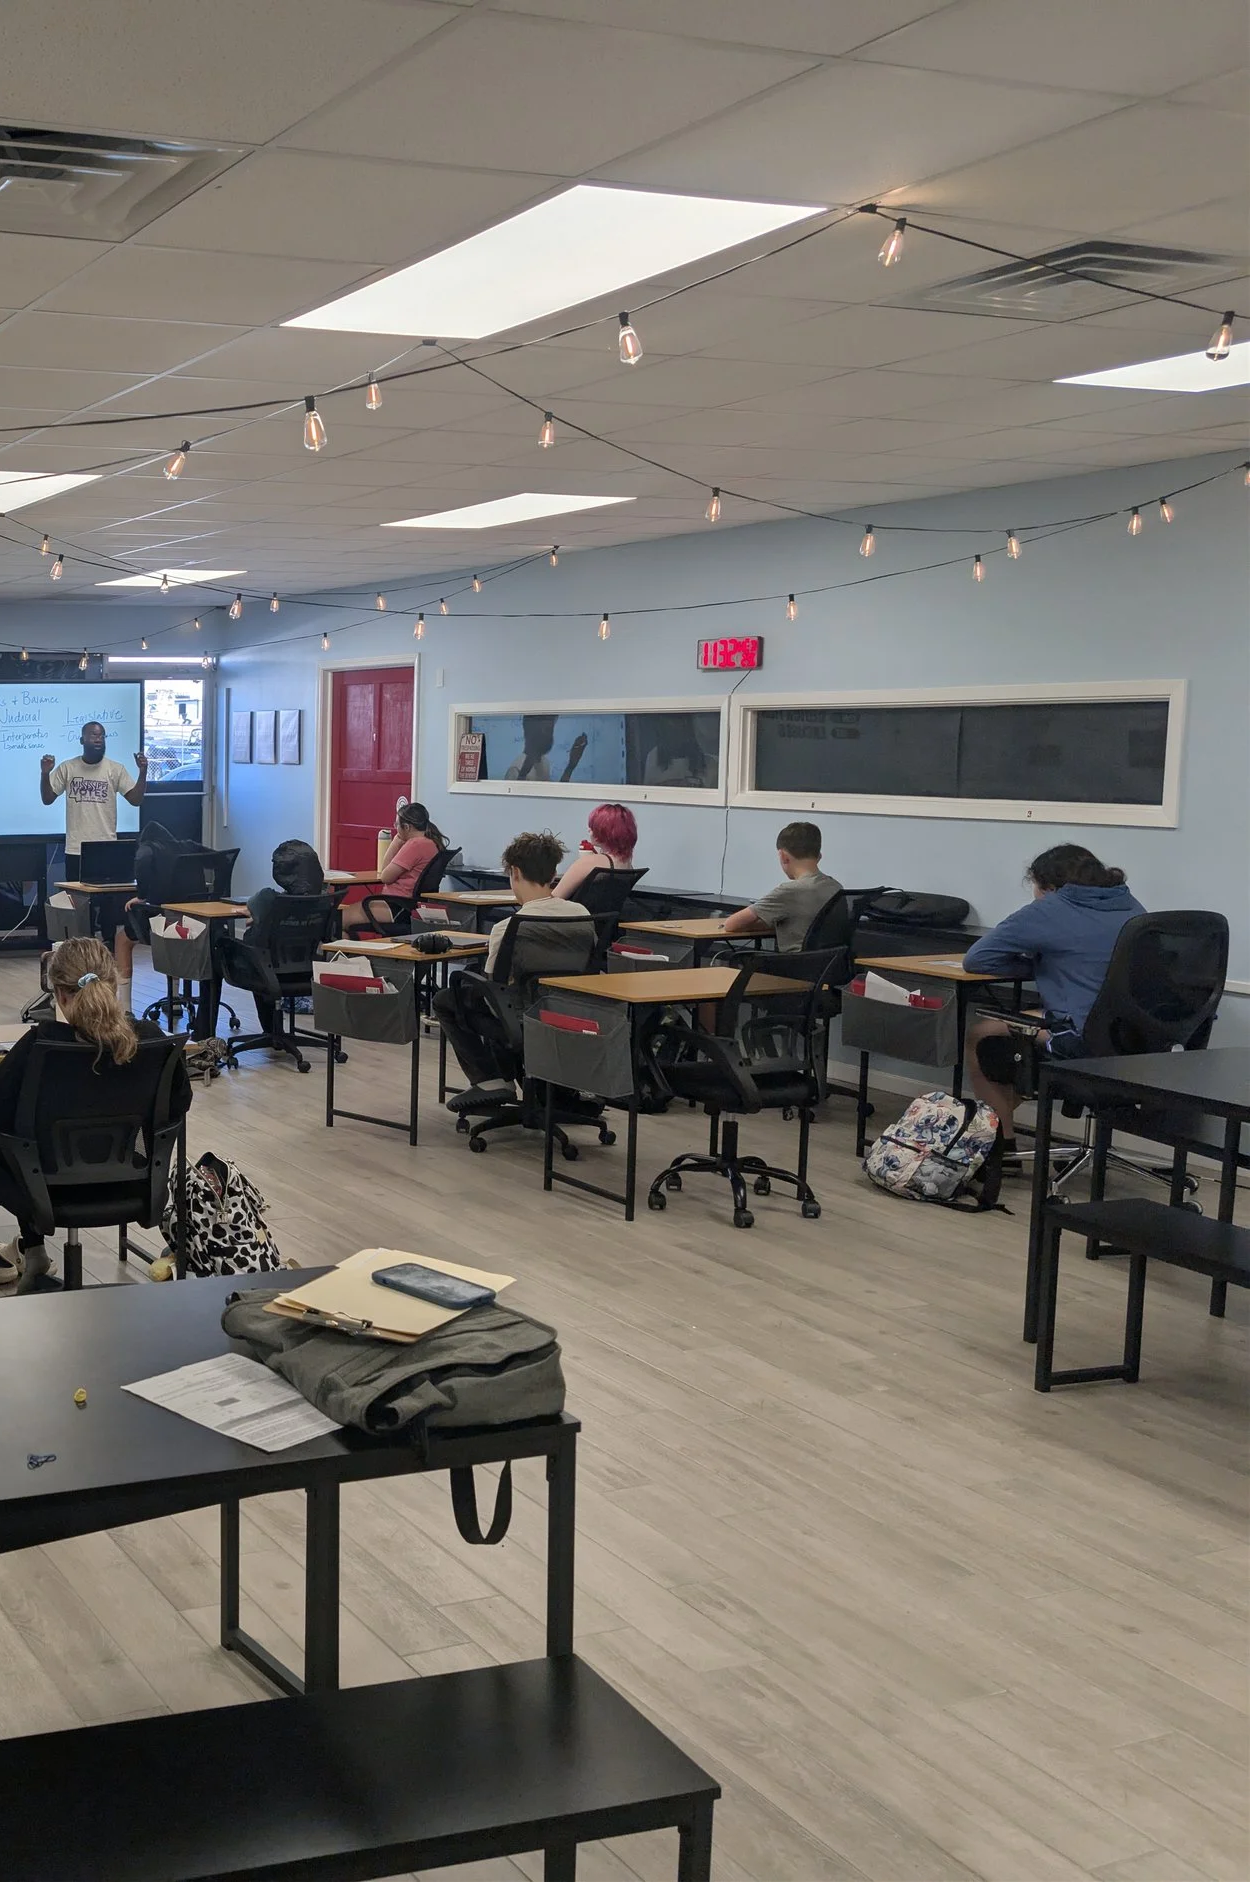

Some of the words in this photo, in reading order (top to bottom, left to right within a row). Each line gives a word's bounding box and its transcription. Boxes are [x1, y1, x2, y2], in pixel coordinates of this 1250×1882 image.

[0, 708, 41, 724] Judicial
[66, 707, 124, 724] Legislative
[465, 735, 477, 744] NO
[72, 787, 108, 798] VOTES
